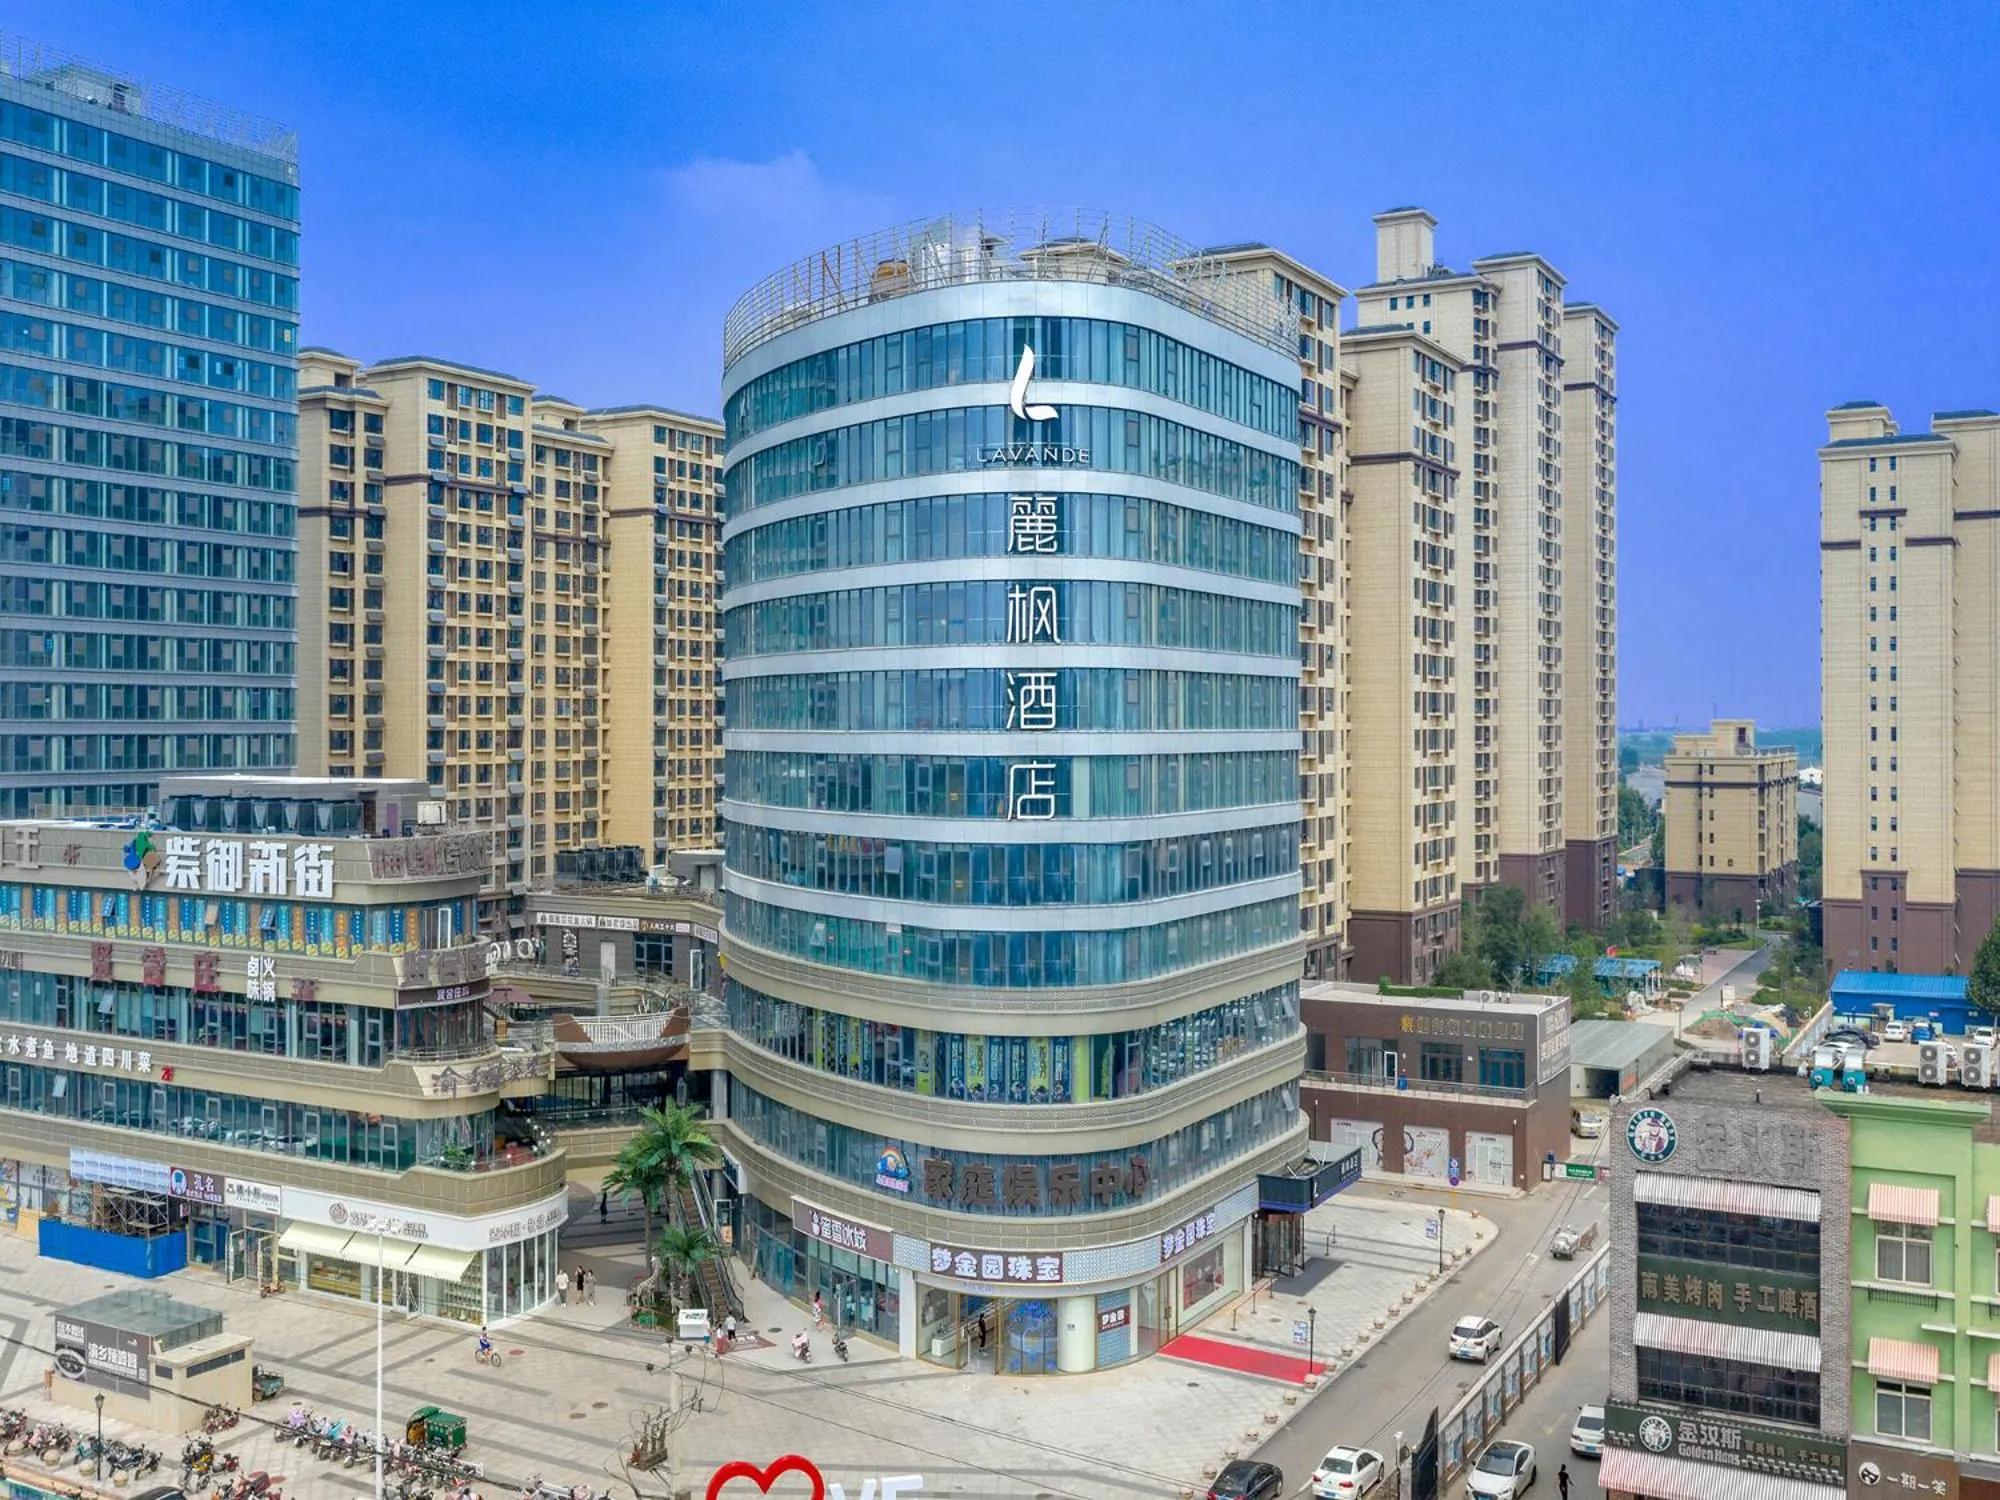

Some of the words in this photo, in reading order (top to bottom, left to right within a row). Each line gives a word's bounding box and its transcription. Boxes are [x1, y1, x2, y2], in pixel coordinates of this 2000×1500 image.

[976, 447, 1091, 464] LAVANDE
[64, 1041, 152, 1074] 地道四川菜
[819, 1215, 868, 1251] 蜜雪冰城
[1161, 1211, 1216, 1261] 梦金园珠宝
[931, 1246, 1061, 1282] 梦金园珠宝
[1640, 1269, 1724, 1311] 南美烤肉
[1733, 1281, 1818, 1322] 手工啤酒
[1677, 1420, 1743, 1451] 金汉斯
